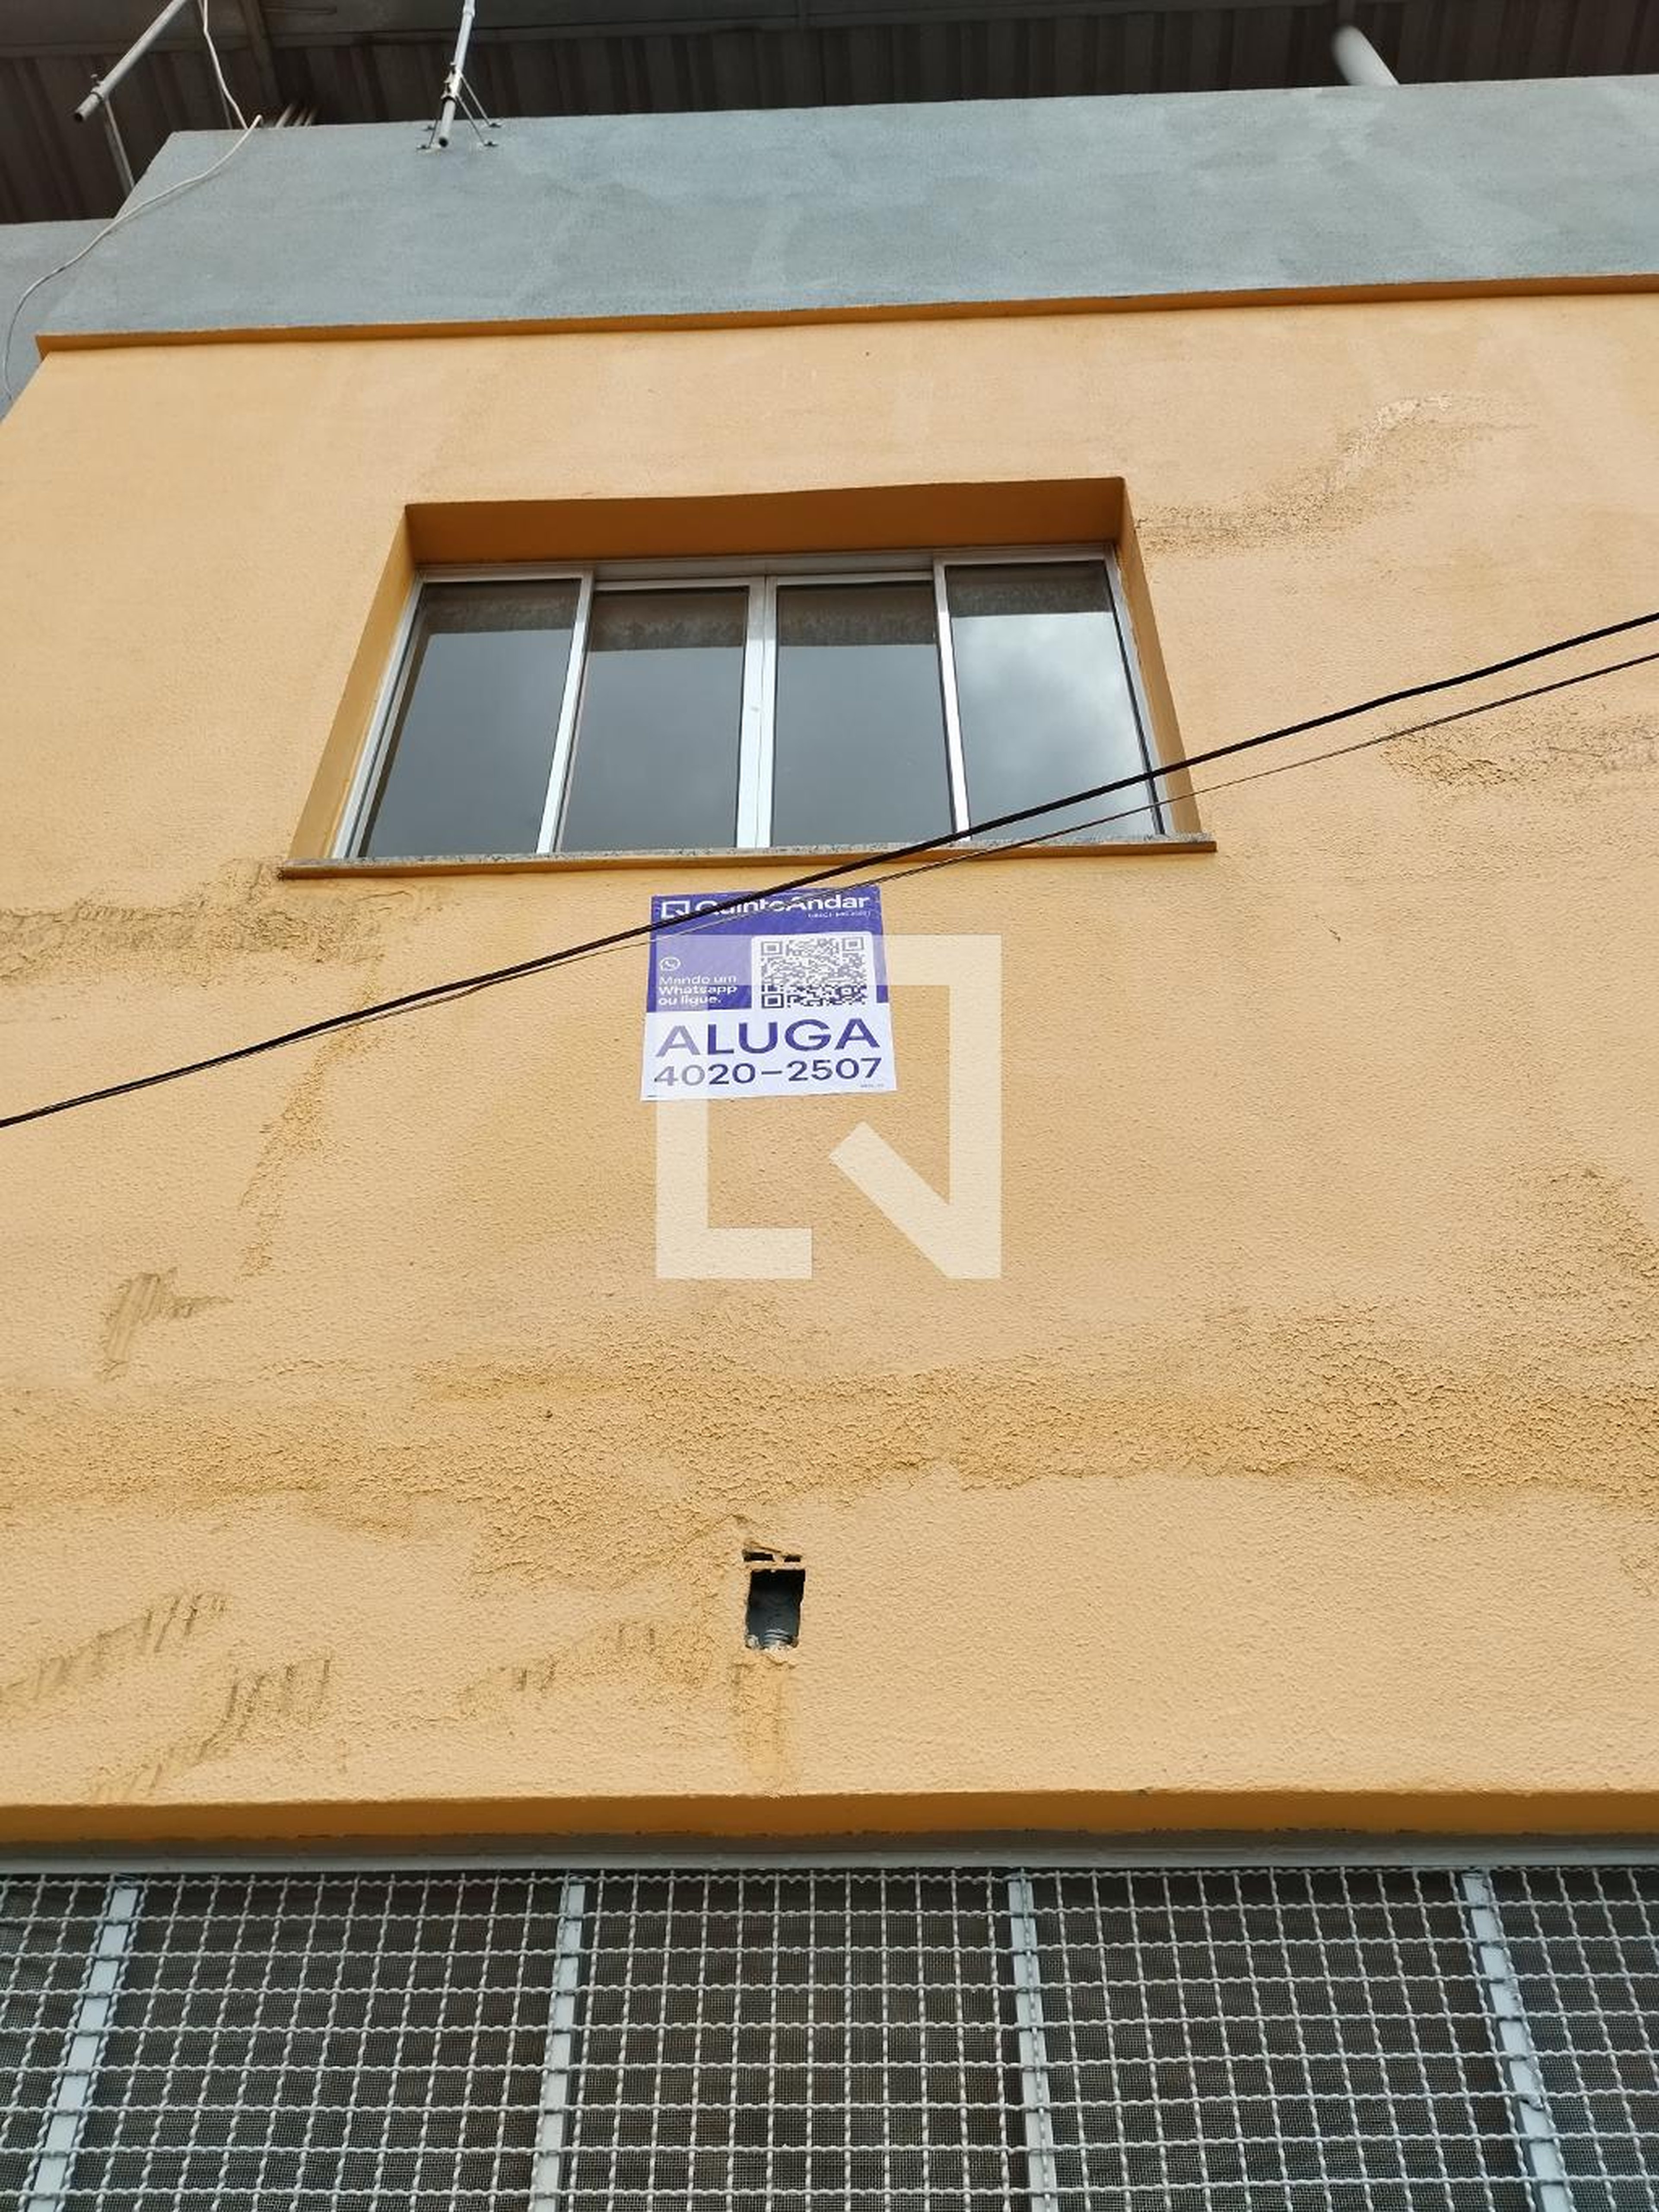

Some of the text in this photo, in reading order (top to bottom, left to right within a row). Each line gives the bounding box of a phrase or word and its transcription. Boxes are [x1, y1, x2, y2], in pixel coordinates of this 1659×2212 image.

[659, 986, 737, 995] Whatsapp
[659, 995, 721, 1007] ou ligue.
[656, 1018, 880, 1057] ALUGA
[654, 1057, 882, 1086] 4020-2507
